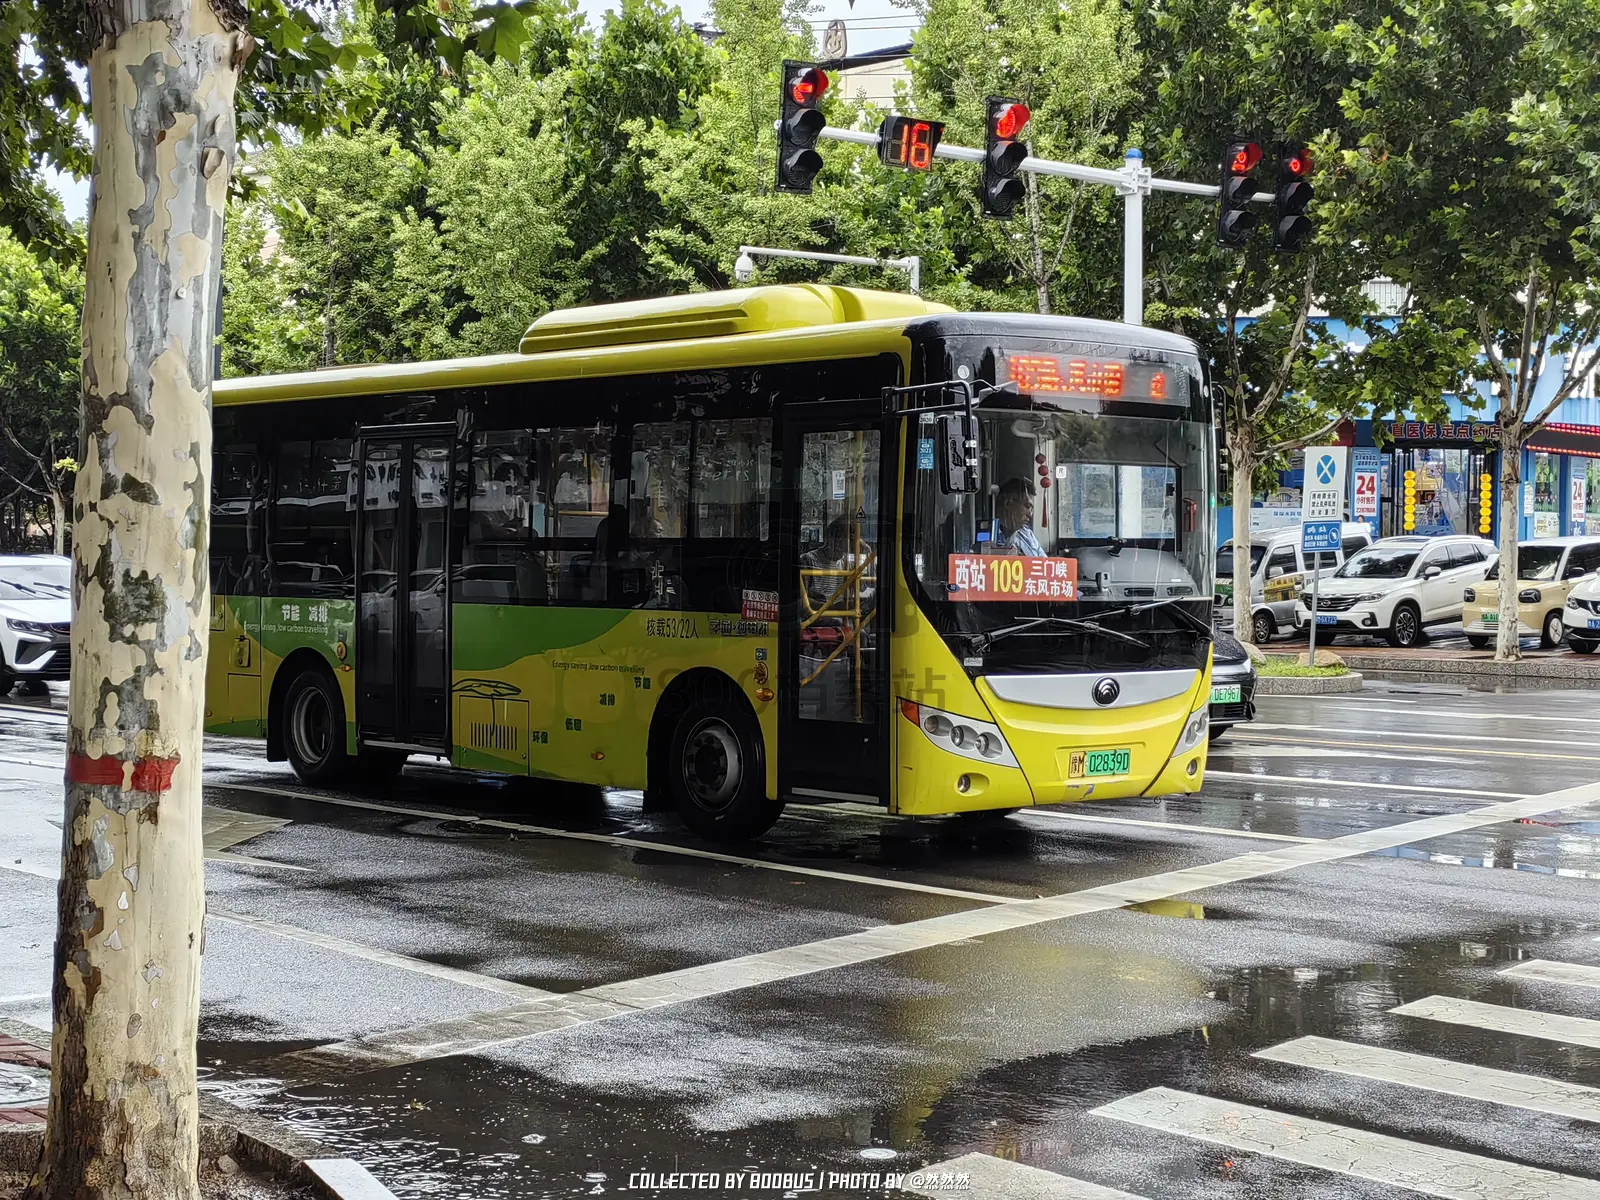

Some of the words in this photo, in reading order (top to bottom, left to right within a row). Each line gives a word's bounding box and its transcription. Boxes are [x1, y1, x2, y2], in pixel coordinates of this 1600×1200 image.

[900, 123, 930, 168] 16
[1387, 423, 1501, 439] 直医保定点药店
[1356, 475, 1376, 495] 24
[1573, 481, 1583, 500] 24
[955, 558, 986, 592] 西站
[989, 559, 1024, 593] 109
[1030, 560, 1068, 578] 三门峡
[1024, 578, 1073, 598] 东风市场
[281, 604, 300, 621] 节能
[647, 618, 699, 639] 核载53/22人
[552, 660, 570, 670] Energy
[570, 662, 588, 671] saving
[1089, 752, 1129, 773] 02839D
